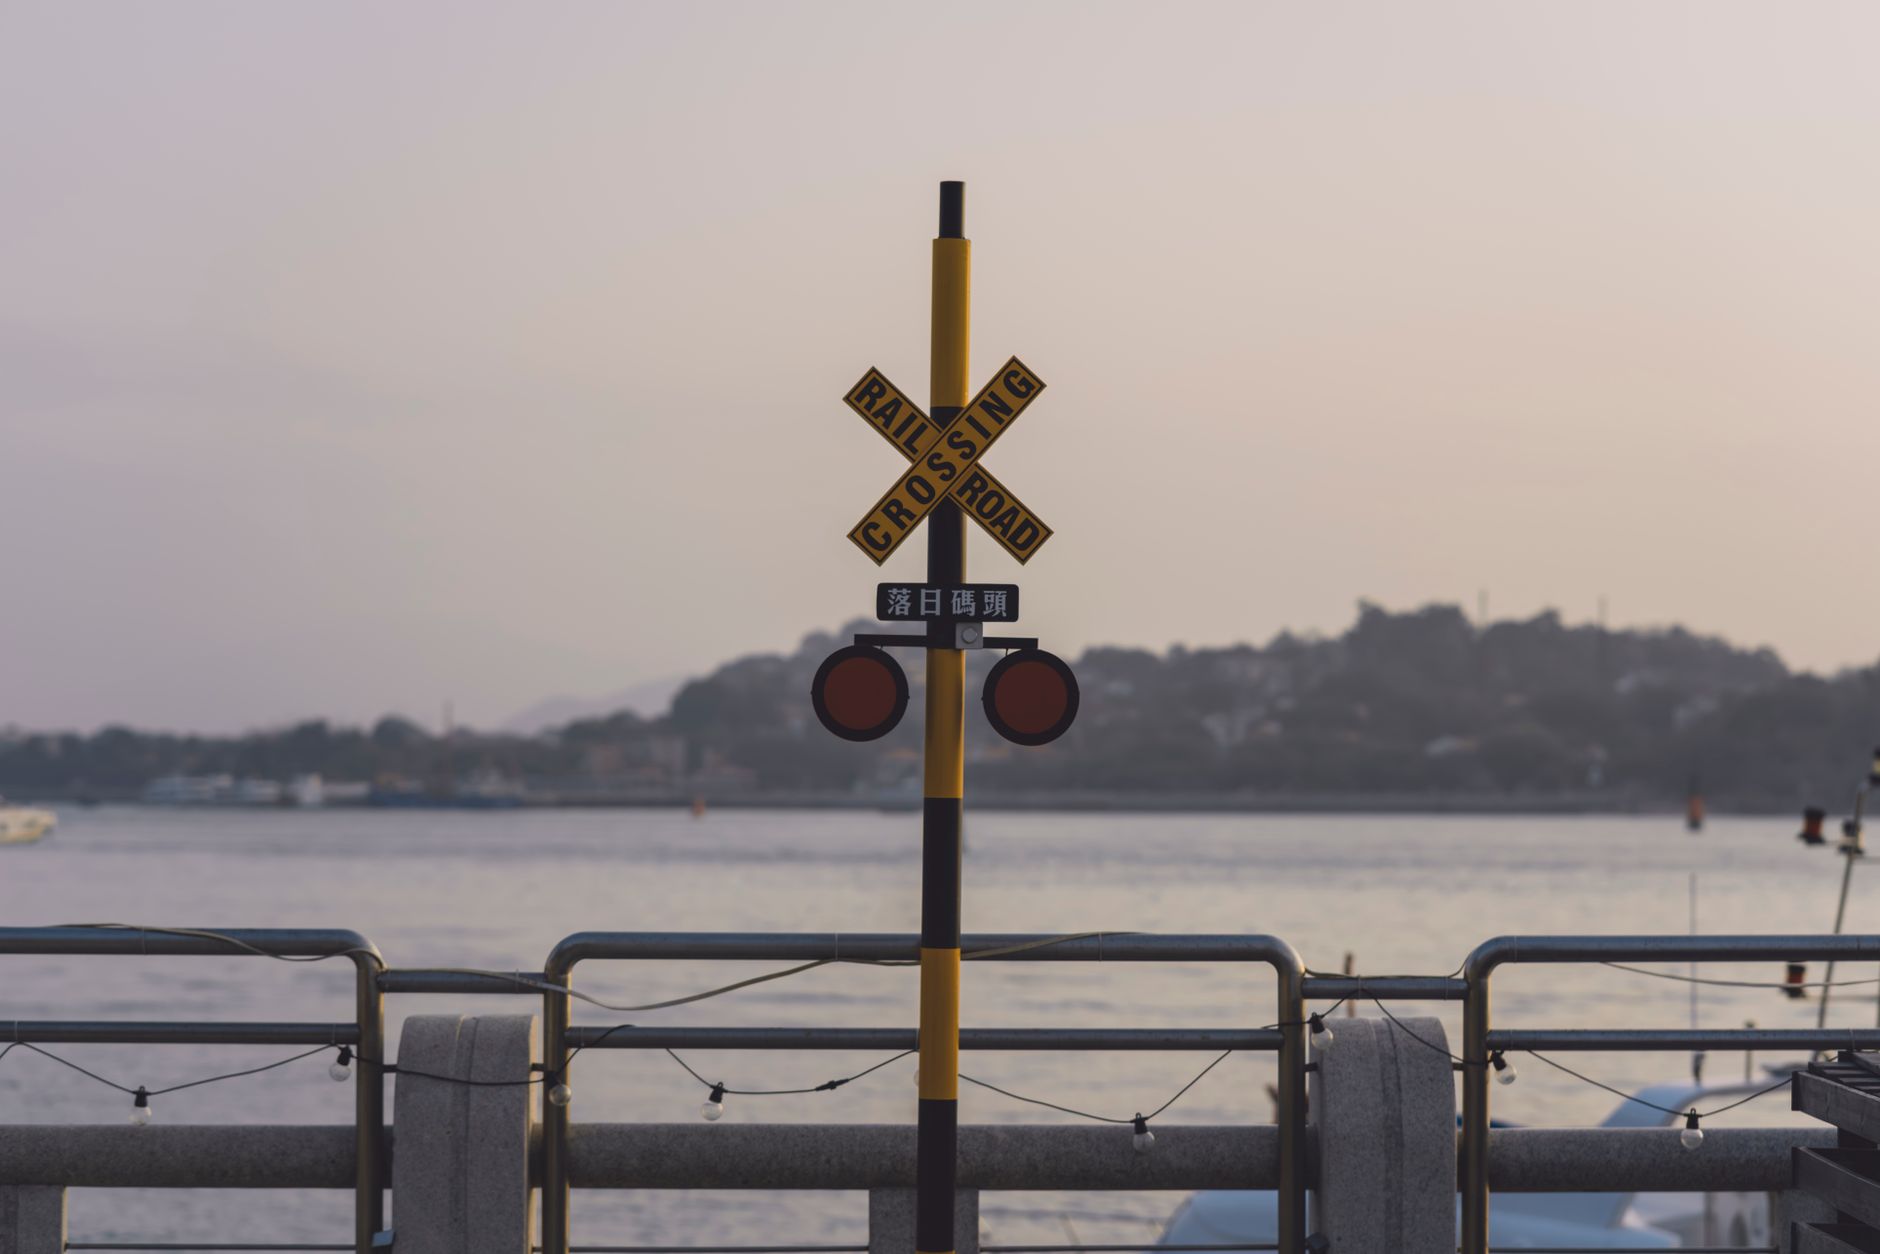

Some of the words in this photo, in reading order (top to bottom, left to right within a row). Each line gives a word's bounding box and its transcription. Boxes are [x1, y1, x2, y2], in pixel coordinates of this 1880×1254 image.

[854, 376, 929, 455] RAIL
[956, 471, 1040, 551] ROAD
[861, 369, 1036, 552] CROSSING
[887, 588, 1008, 617] 落日碼頭
